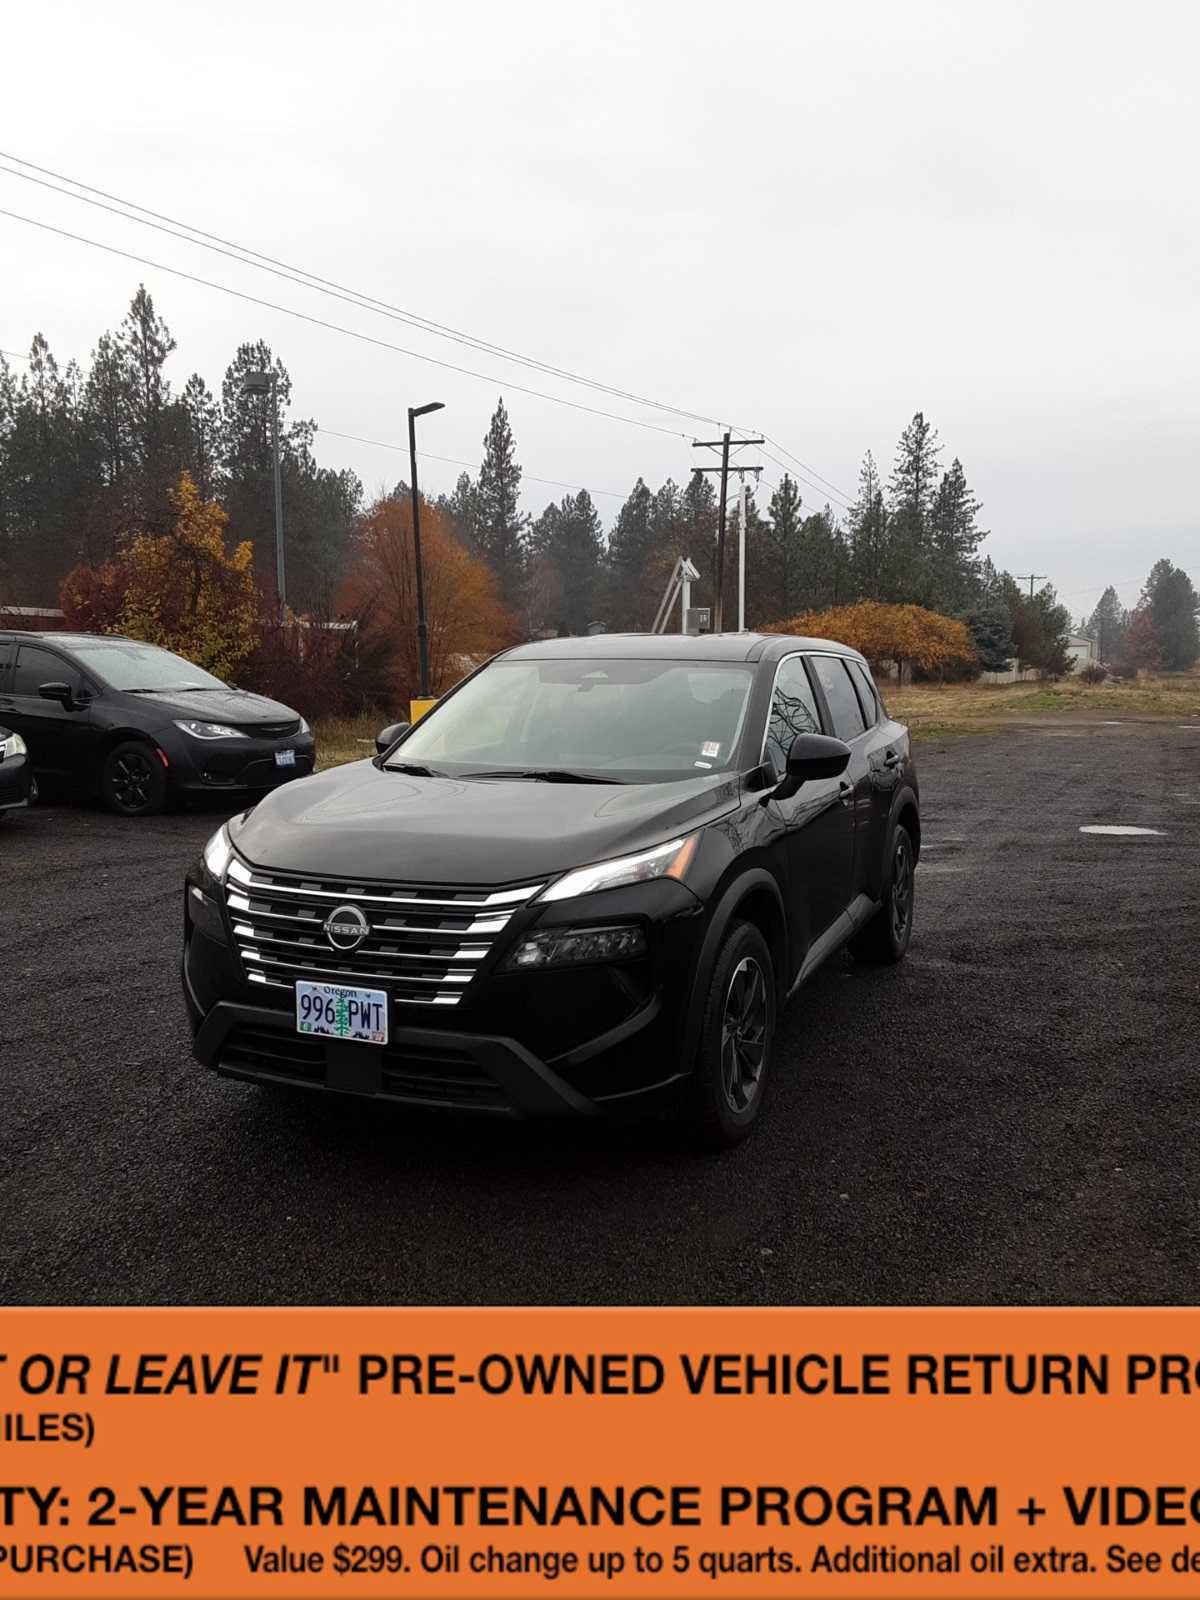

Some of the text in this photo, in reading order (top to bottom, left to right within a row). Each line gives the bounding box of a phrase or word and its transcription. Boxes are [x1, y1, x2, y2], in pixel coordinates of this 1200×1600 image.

[323, 922, 370, 936] NISSAN
[323, 986, 357, 998] Oregon
[301, 994, 383, 1031] 996 PWT
